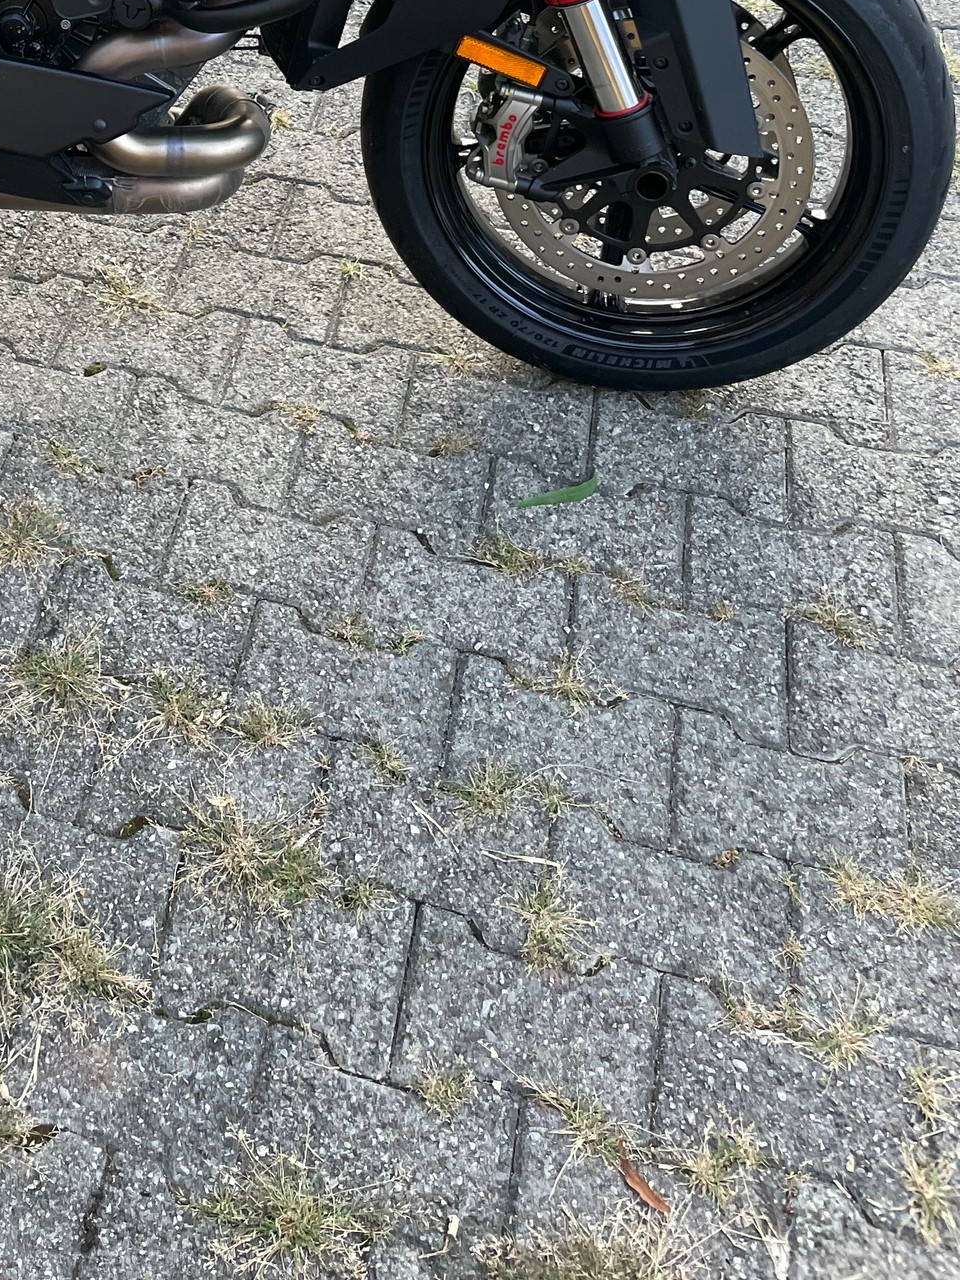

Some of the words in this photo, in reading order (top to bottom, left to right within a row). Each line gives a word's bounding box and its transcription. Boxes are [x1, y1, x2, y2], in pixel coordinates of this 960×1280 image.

[491, 114, 518, 167] brembo
[472, 292, 487, 305] 17
[489, 304, 505, 319] ZR
[510, 320, 559, 348] 120/70
[571, 347, 672, 370] MICHELIN
